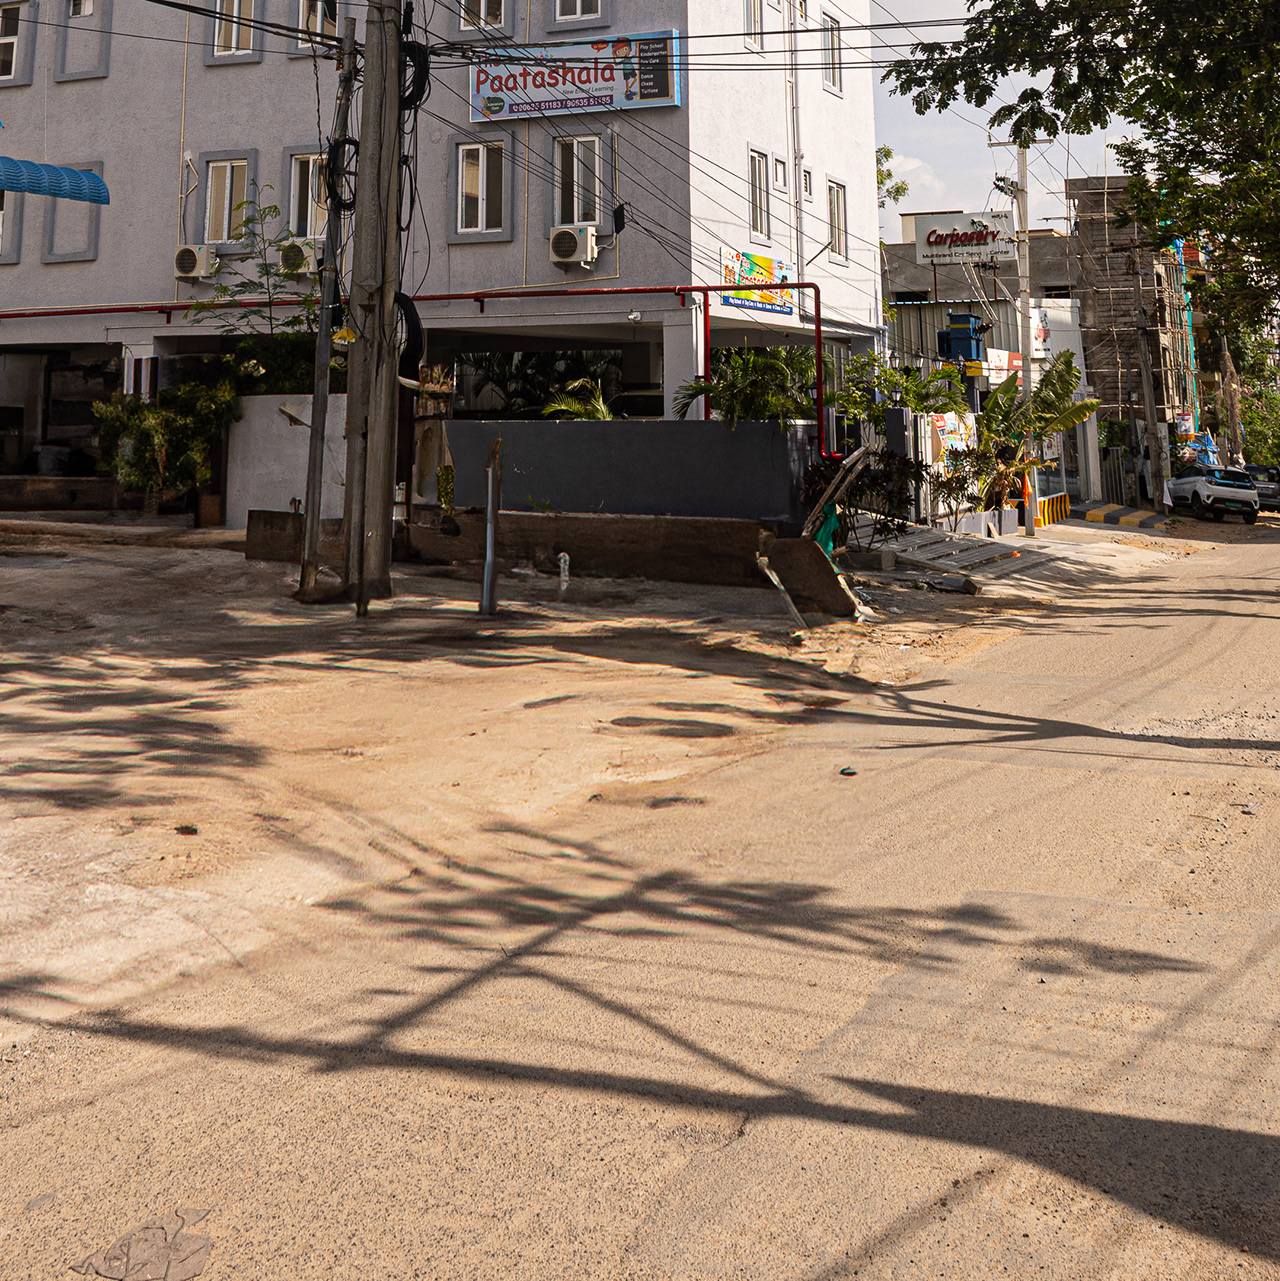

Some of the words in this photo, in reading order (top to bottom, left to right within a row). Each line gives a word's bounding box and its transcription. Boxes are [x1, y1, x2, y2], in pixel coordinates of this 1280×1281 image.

[475, 57, 616, 94] Paatashala
[540, 101, 561, 109] 51183
[926, 227, 1000, 248] Carposerv
[922, 251, 953, 259] Multibrand
